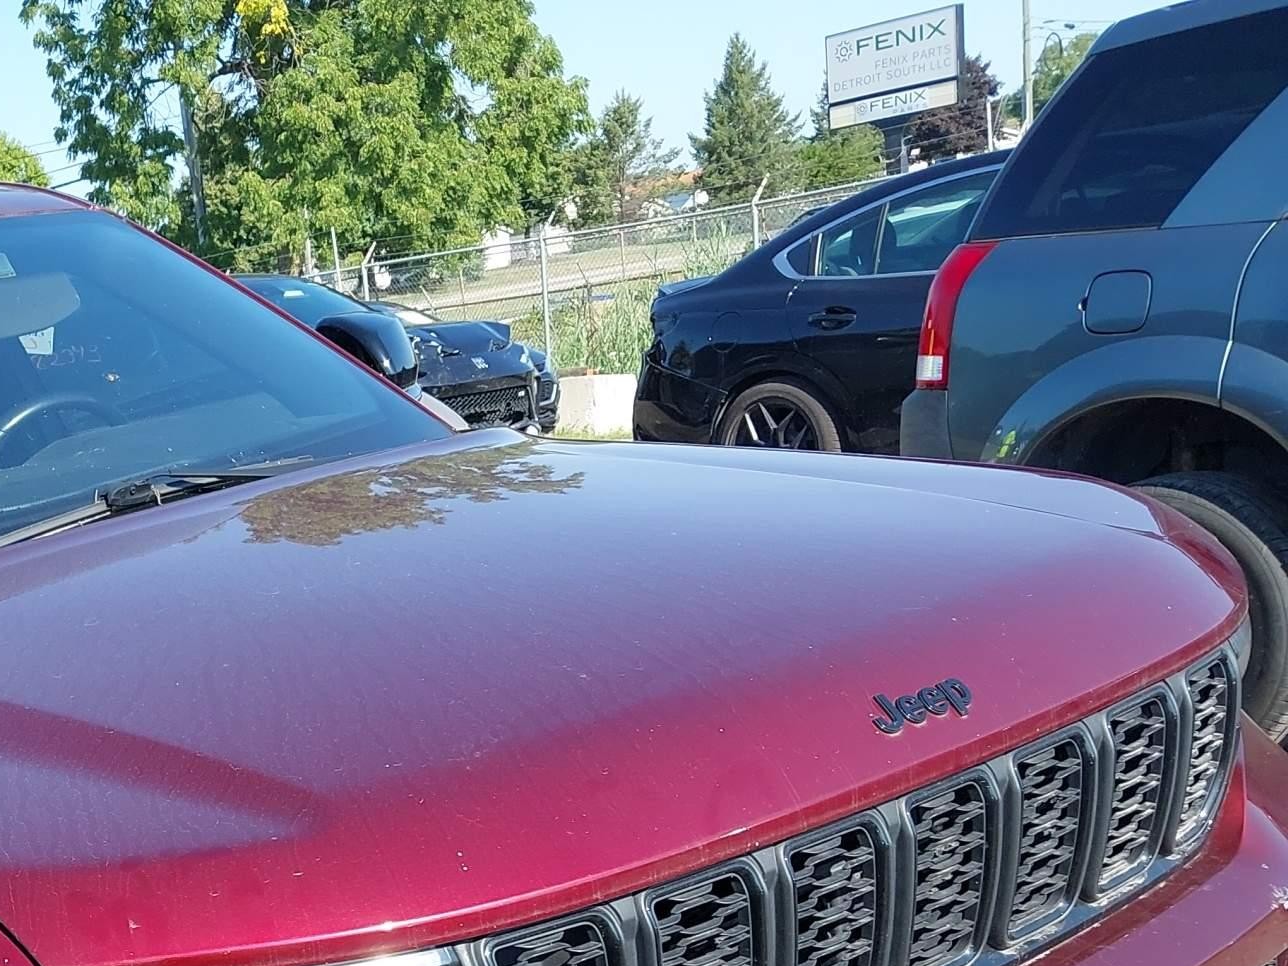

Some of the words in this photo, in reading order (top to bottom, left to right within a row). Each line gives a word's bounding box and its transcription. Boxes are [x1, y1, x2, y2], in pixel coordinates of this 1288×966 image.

[856, 18, 946, 56] FENIX
[833, 72, 882, 92] DETROIT
[886, 64, 926, 80] SOUTH
[930, 57, 952, 71] LLC
[874, 54, 908, 70] FENIX
[912, 44, 951, 62] PARTS
[869, 89, 926, 112] FENIX
[871, 678, 972, 734] Jeep
